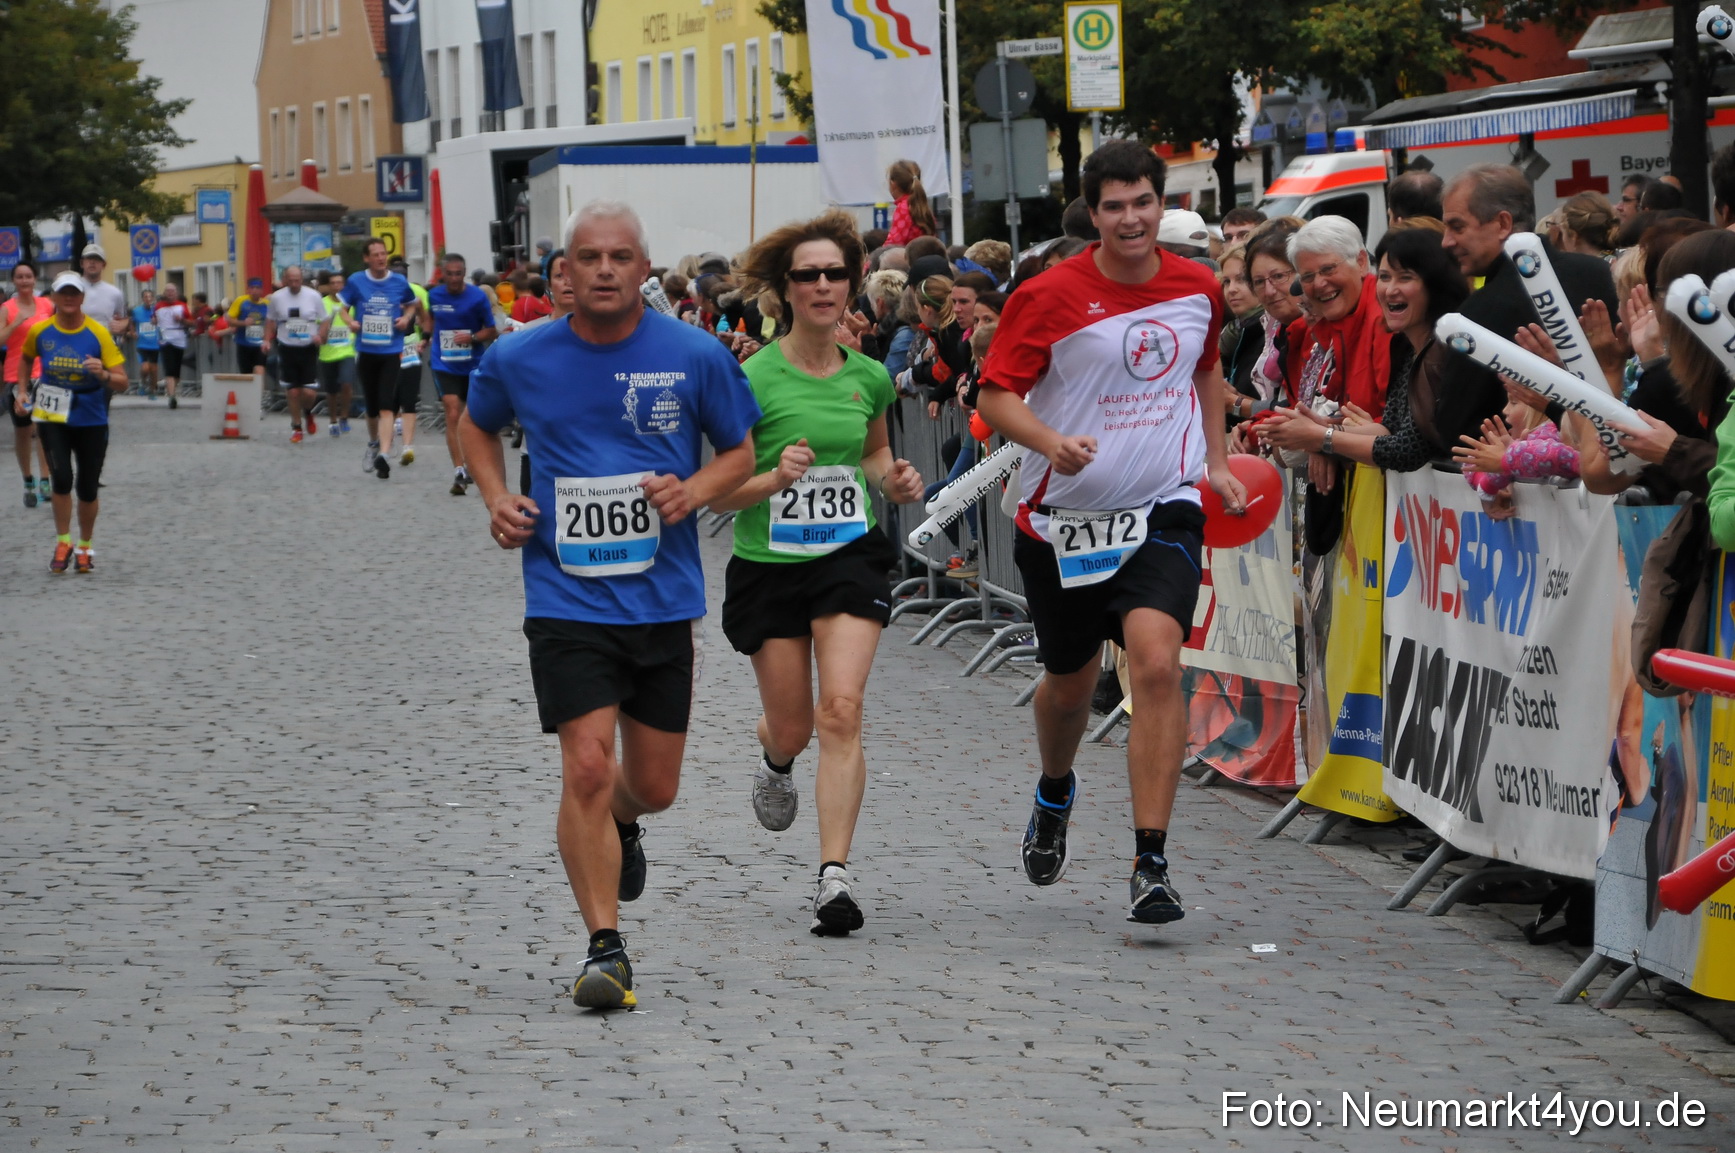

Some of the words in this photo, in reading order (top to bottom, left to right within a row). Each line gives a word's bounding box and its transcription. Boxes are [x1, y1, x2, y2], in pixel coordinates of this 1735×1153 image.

[643, 12, 671, 44] HOTEL
[1008, 43, 1032, 54] Ulmer
[1034, 42, 1059, 52] Gasse
[374, 219, 401, 228] Block
[133, 256, 160, 267] TAXI
[1531, 289, 1577, 350] BMW
[363, 320, 390, 334] 3393
[615, 373, 633, 381] 12.
[631, 372, 686, 380] NEUMARKTER
[629, 380, 675, 388] STADTLAUF
[1098, 393, 1139, 405] LAUFEN
[1119, 406, 1138, 415] Heck
[808, 474, 850, 483] Neumarkt
[557, 487, 586, 498] PARTL
[588, 484, 639, 498] Neumarkt
[781, 486, 856, 519] 2138
[565, 498, 650, 538] 2068
[803, 528, 835, 542] Birgit
[1059, 512, 1138, 551] 2172
[588, 547, 628, 562] Klaus
[1513, 686, 1560, 730] Stadt
[1496, 763, 1541, 808] 92318
[1543, 767, 1602, 818] Neumar
